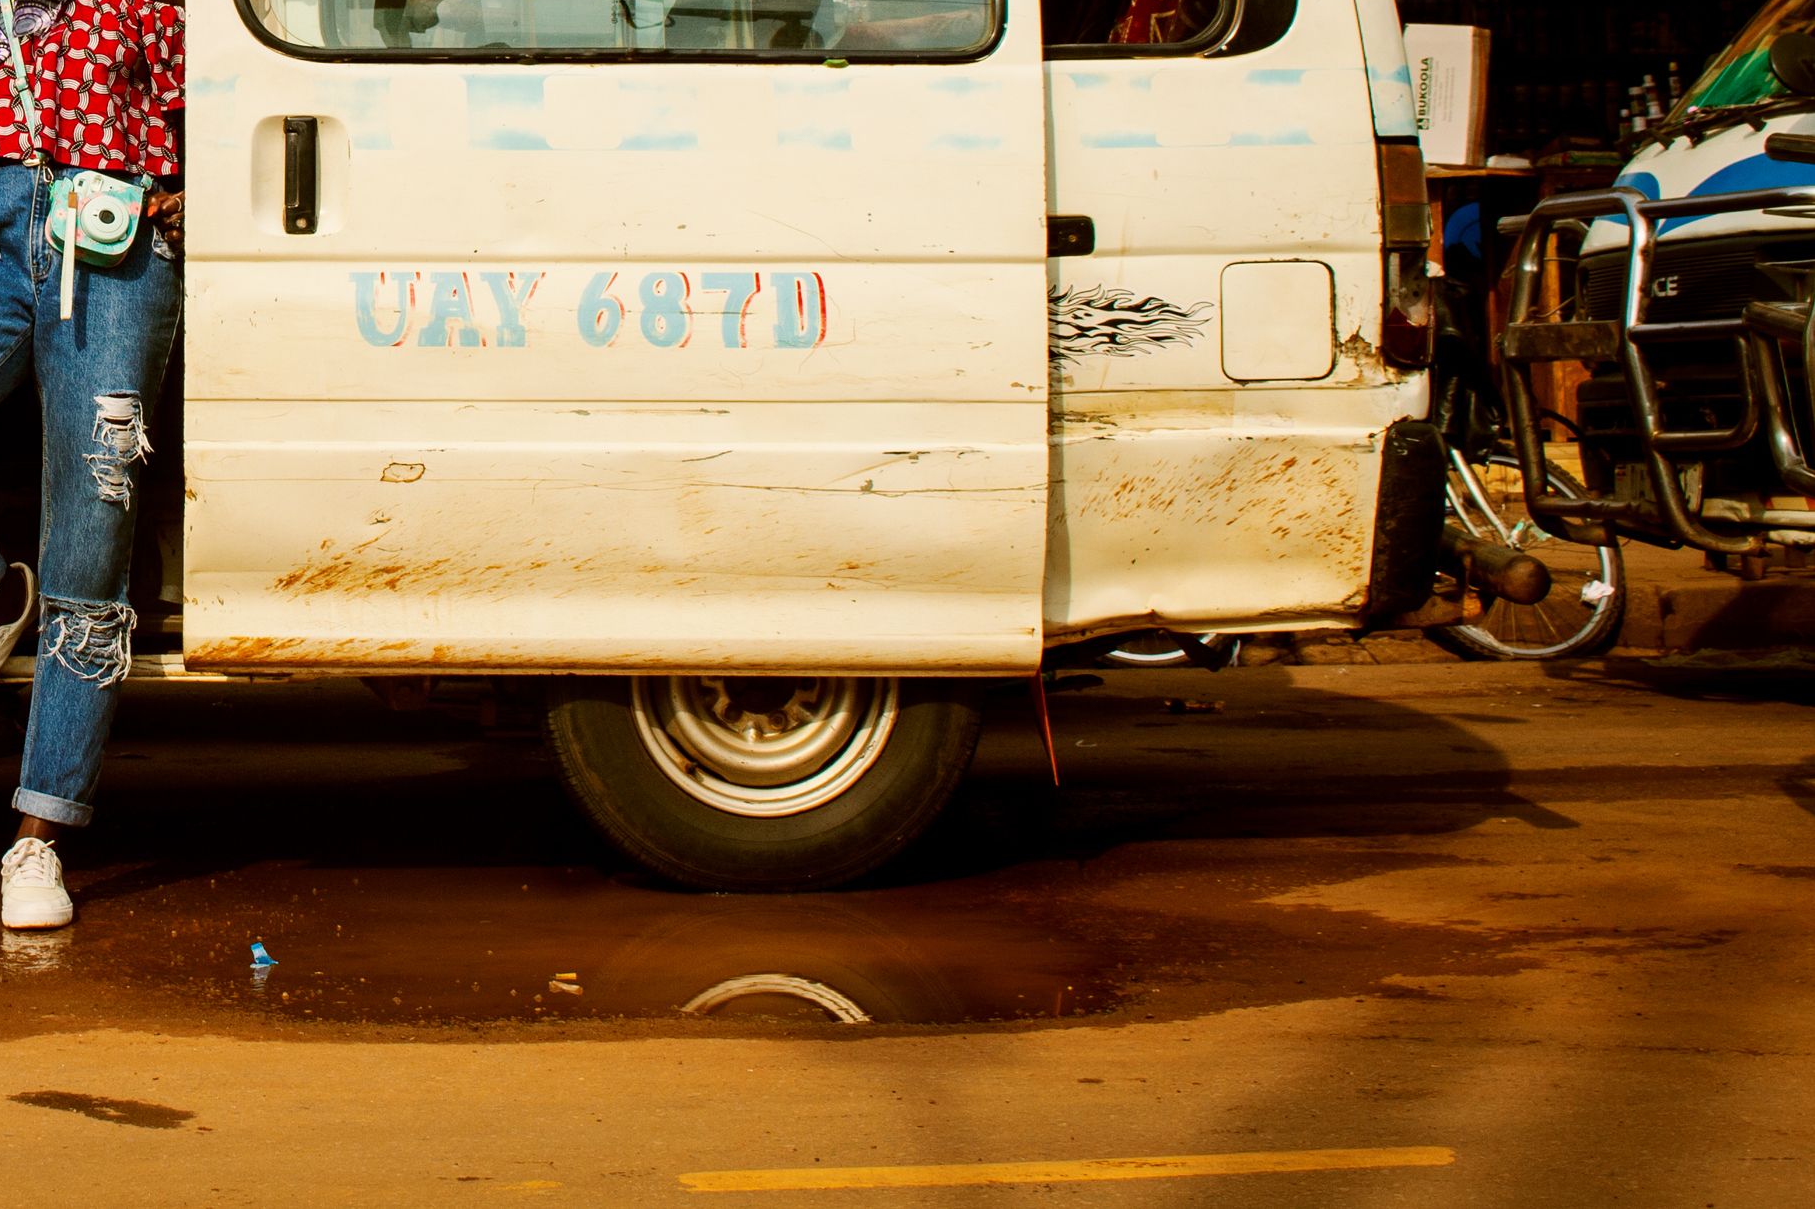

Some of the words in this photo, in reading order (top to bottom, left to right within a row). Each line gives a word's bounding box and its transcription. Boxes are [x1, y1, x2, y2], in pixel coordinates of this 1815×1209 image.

[1417, 57, 1429, 116] BUKOOLA
[349, 271, 546, 348] UAY
[576, 271, 827, 349] 687D
[1652, 276, 1678, 297] CE
